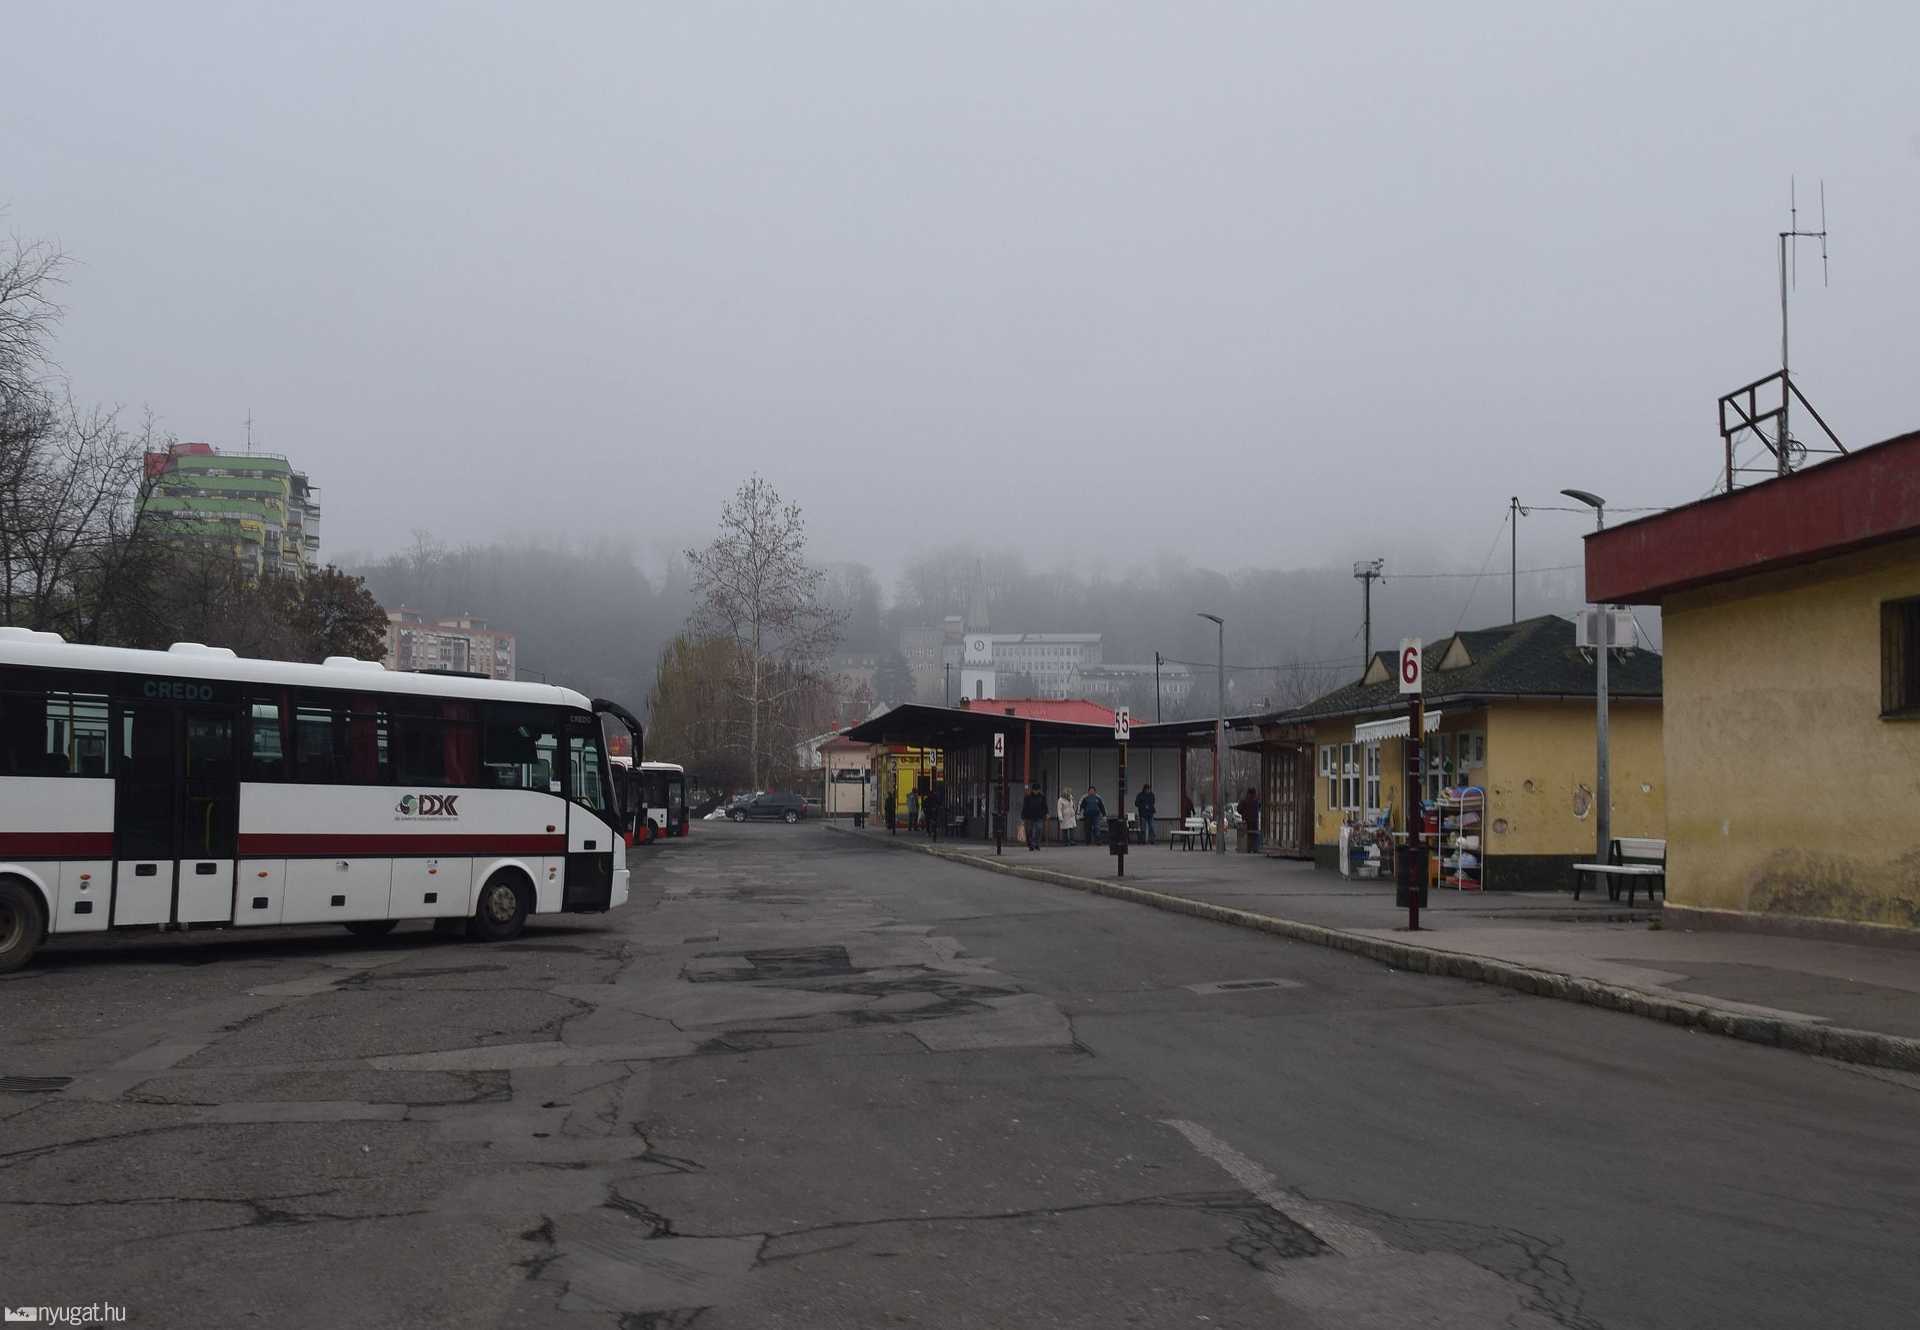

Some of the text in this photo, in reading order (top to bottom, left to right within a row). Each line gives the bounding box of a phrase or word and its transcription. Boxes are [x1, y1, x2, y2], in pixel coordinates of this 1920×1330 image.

[1402, 647, 1418, 684] 6
[143, 681, 213, 701] CREDO
[995, 737, 1003, 753] 4
